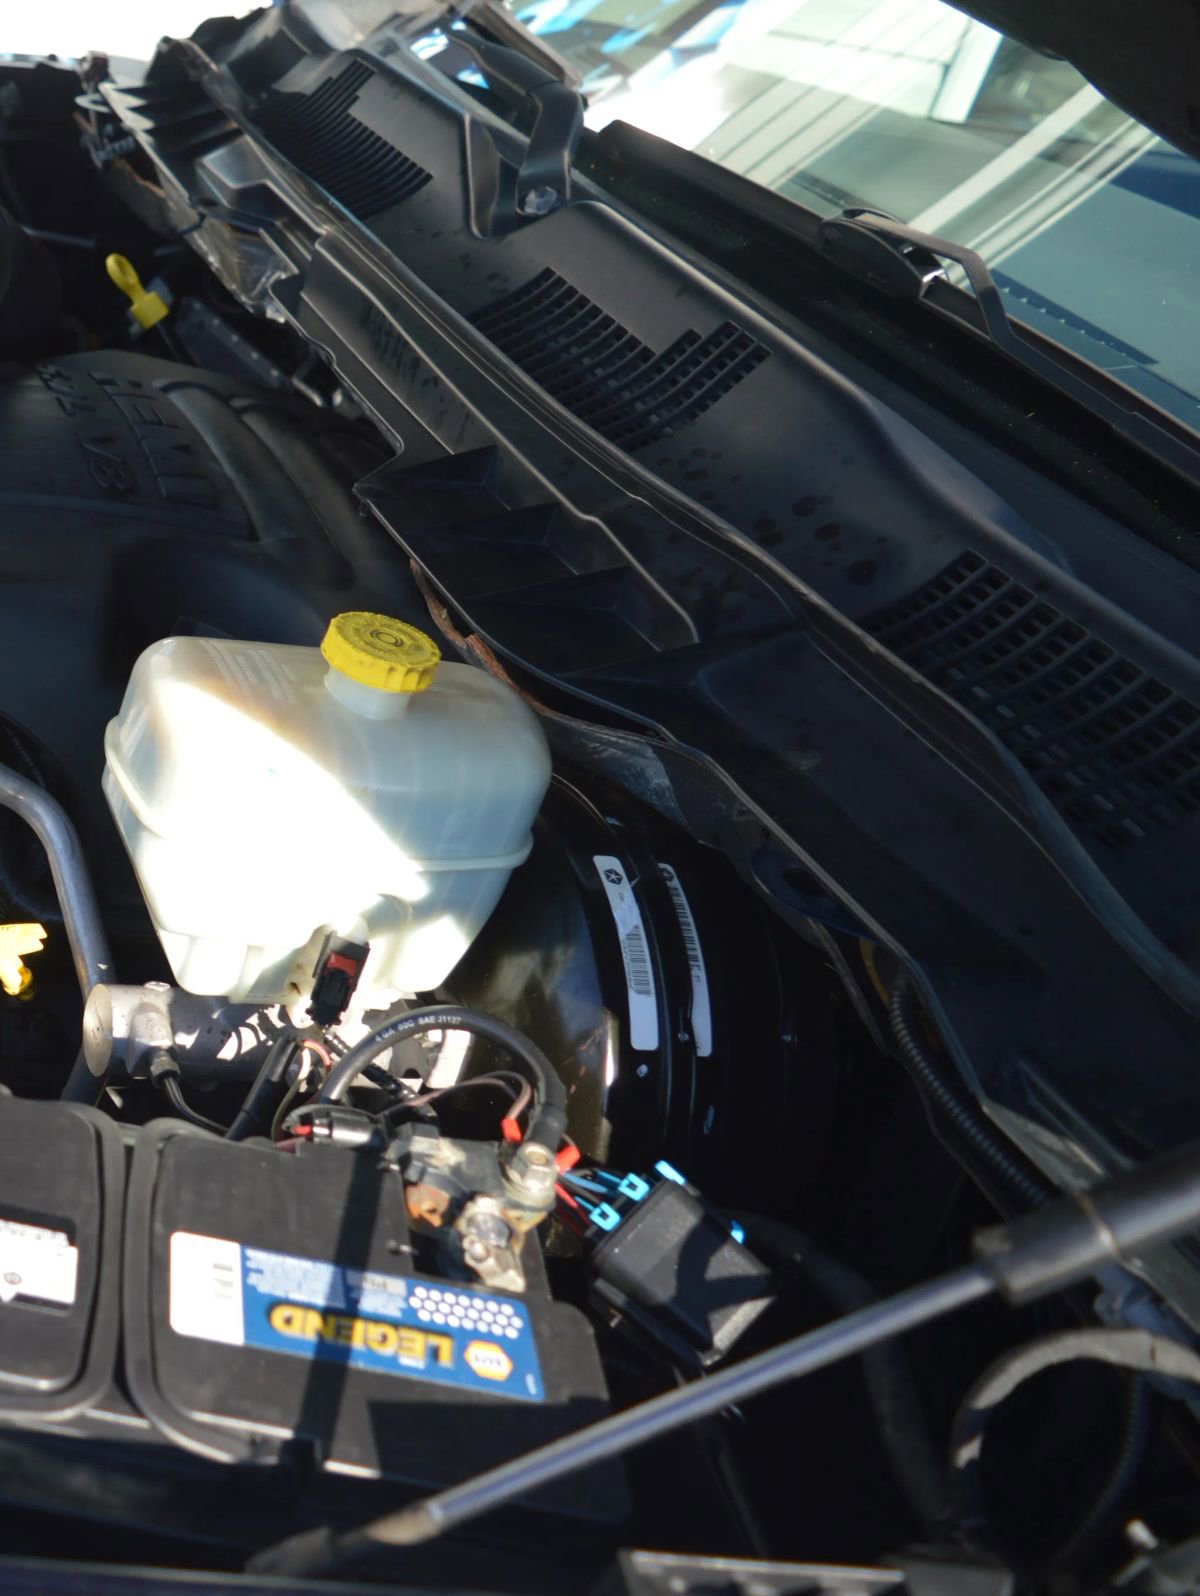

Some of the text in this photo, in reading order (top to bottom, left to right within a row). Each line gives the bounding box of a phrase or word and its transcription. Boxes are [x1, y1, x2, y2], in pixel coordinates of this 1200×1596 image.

[418, 1015, 436, 1025] SAE
[437, 1015, 462, 1025] J1127
[269, 1303, 455, 1366] LEGEND
